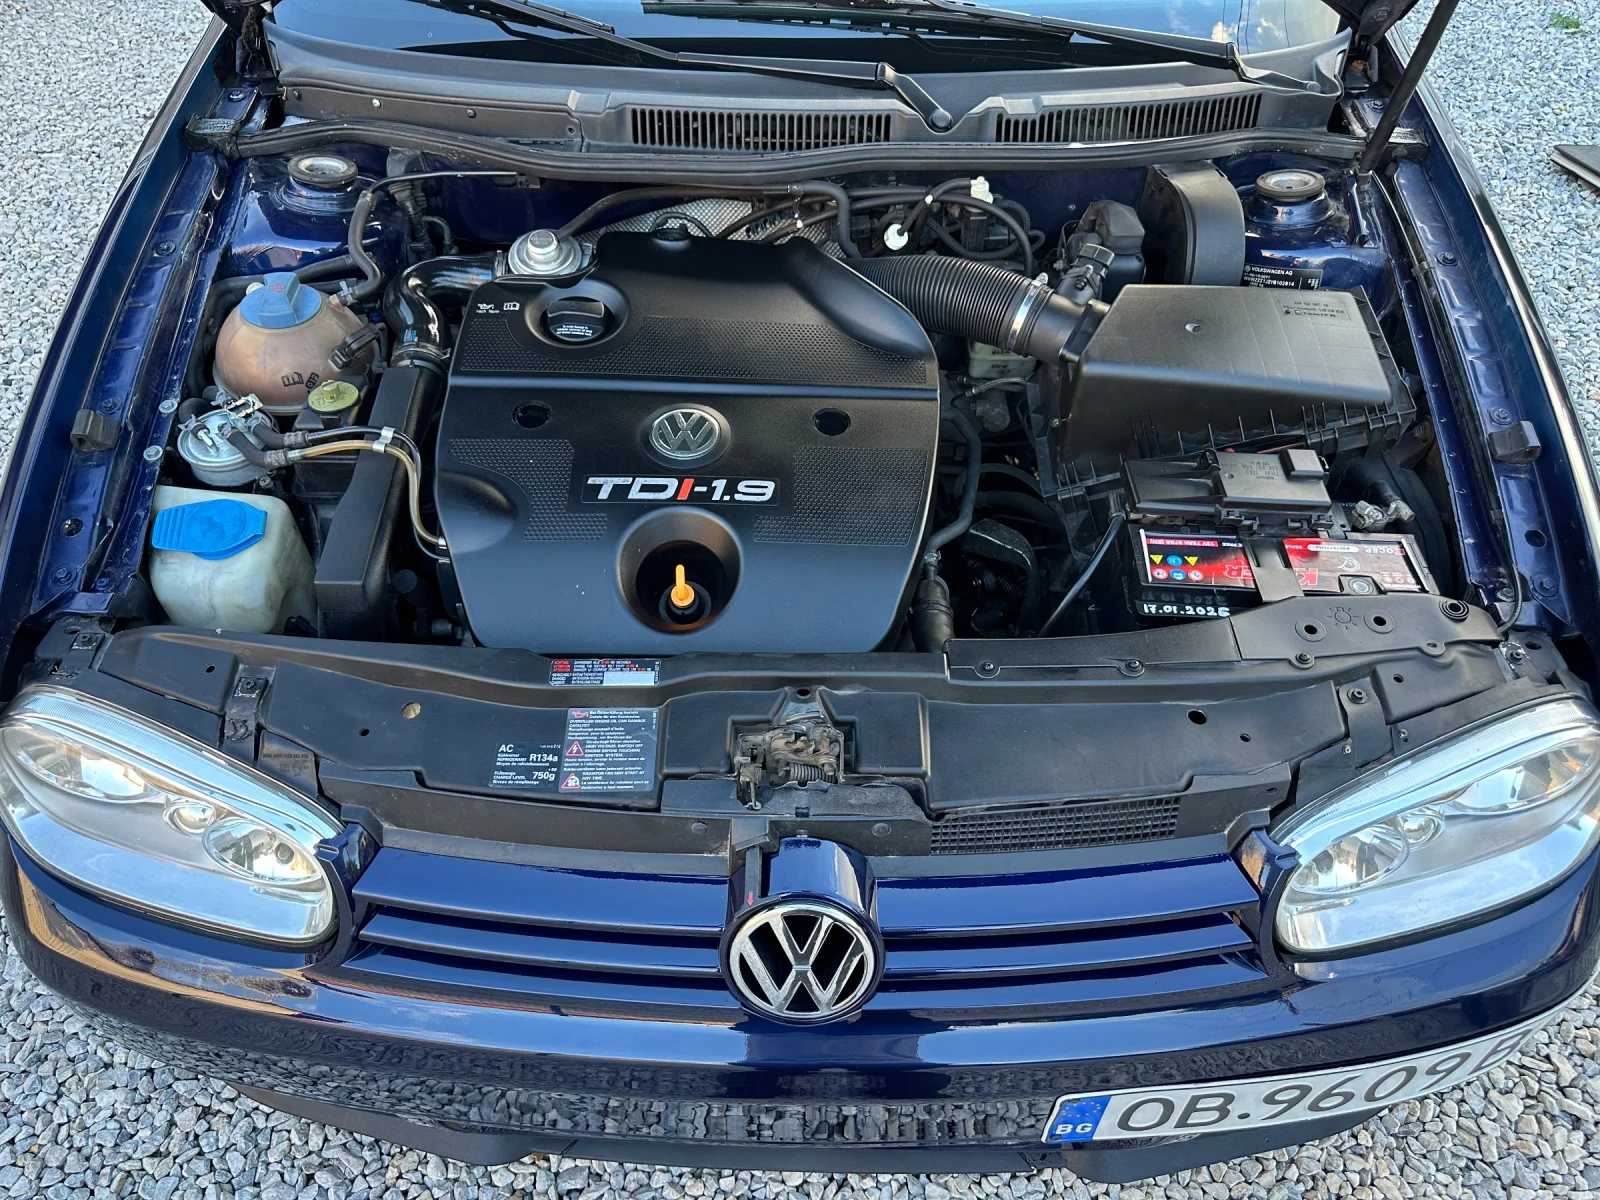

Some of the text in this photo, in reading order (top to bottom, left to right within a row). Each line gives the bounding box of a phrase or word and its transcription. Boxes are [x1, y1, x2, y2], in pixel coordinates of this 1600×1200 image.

[499, 744, 514, 752] AC
[532, 772, 555, 781] 750g
[1056, 1123, 1092, 1134] BG
